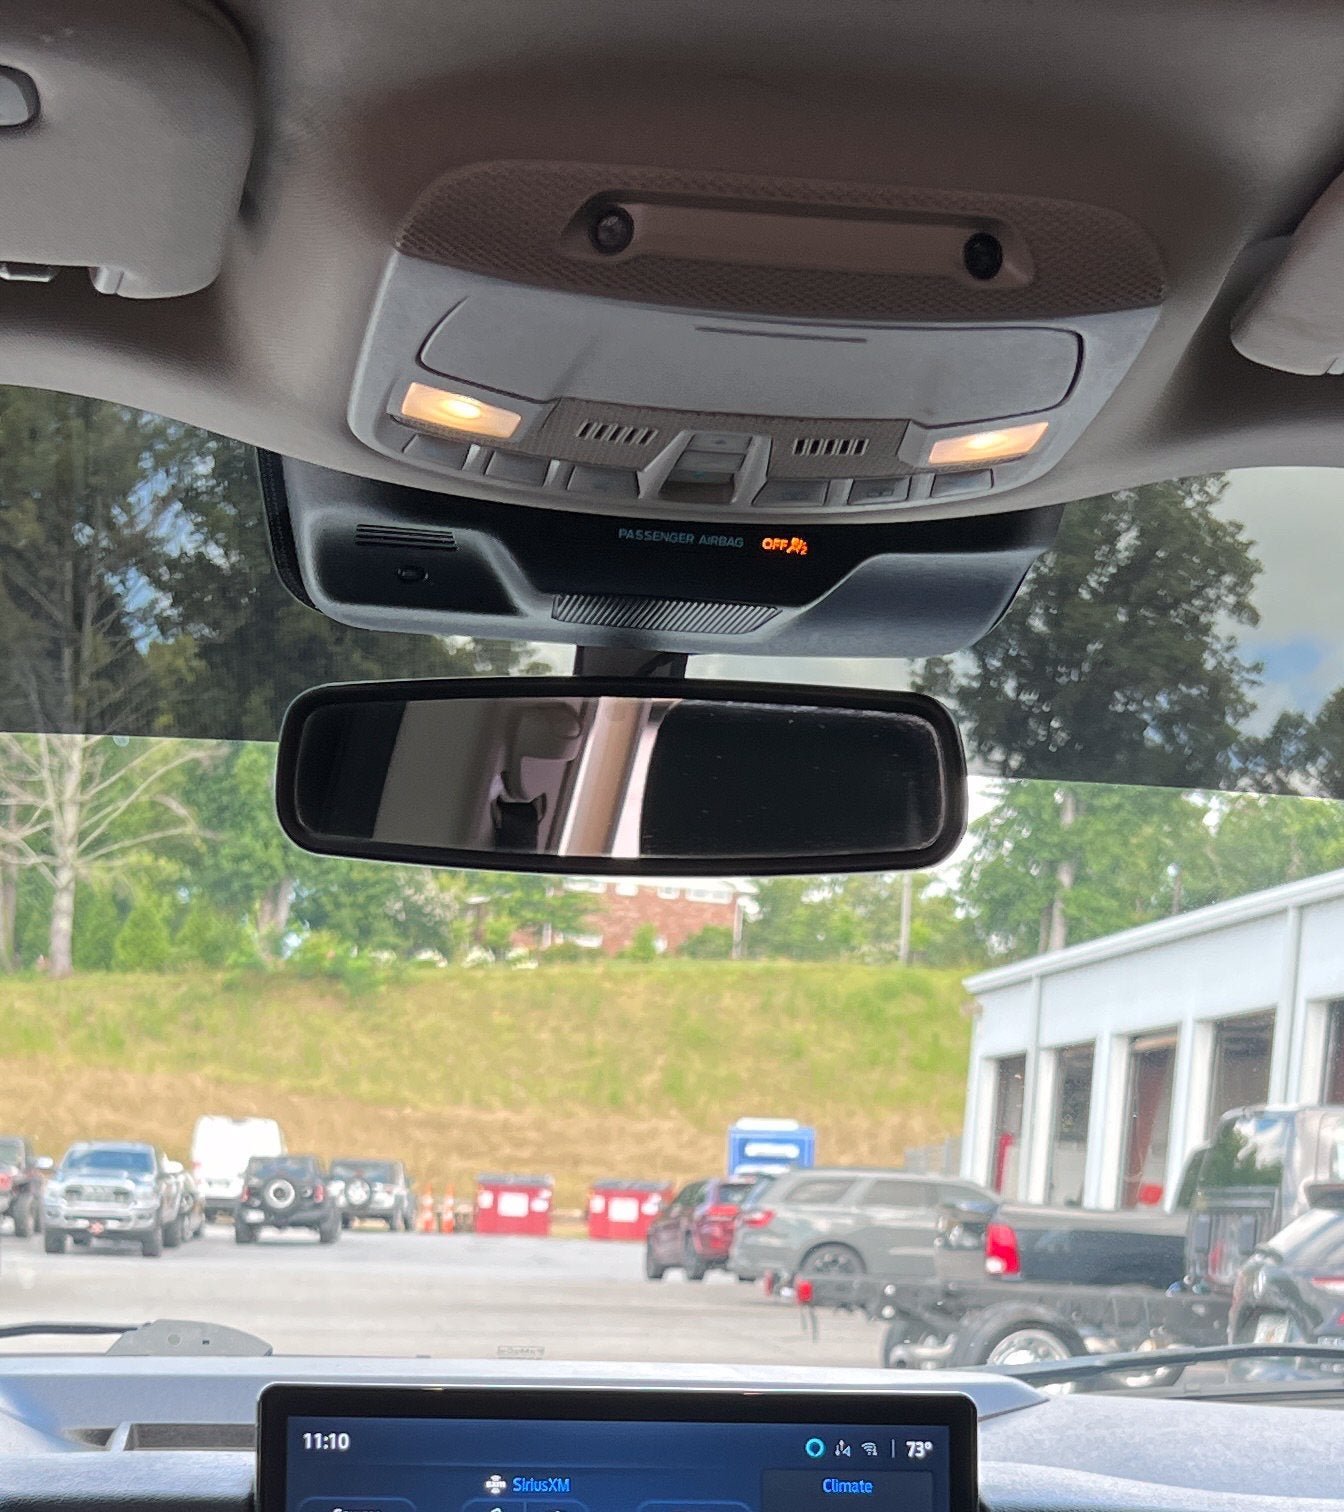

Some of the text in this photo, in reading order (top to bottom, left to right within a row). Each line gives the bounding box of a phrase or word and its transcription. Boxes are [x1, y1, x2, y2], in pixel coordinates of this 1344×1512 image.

[618, 528, 745, 548] PASSENGER AIRBAG
[762, 537, 788, 551] OFF
[303, 1433, 350, 1450] 11:10
[906, 1441, 933, 1459] 73°
[512, 1477, 570, 1492] SiriusXM
[822, 1479, 874, 1494] Climate
